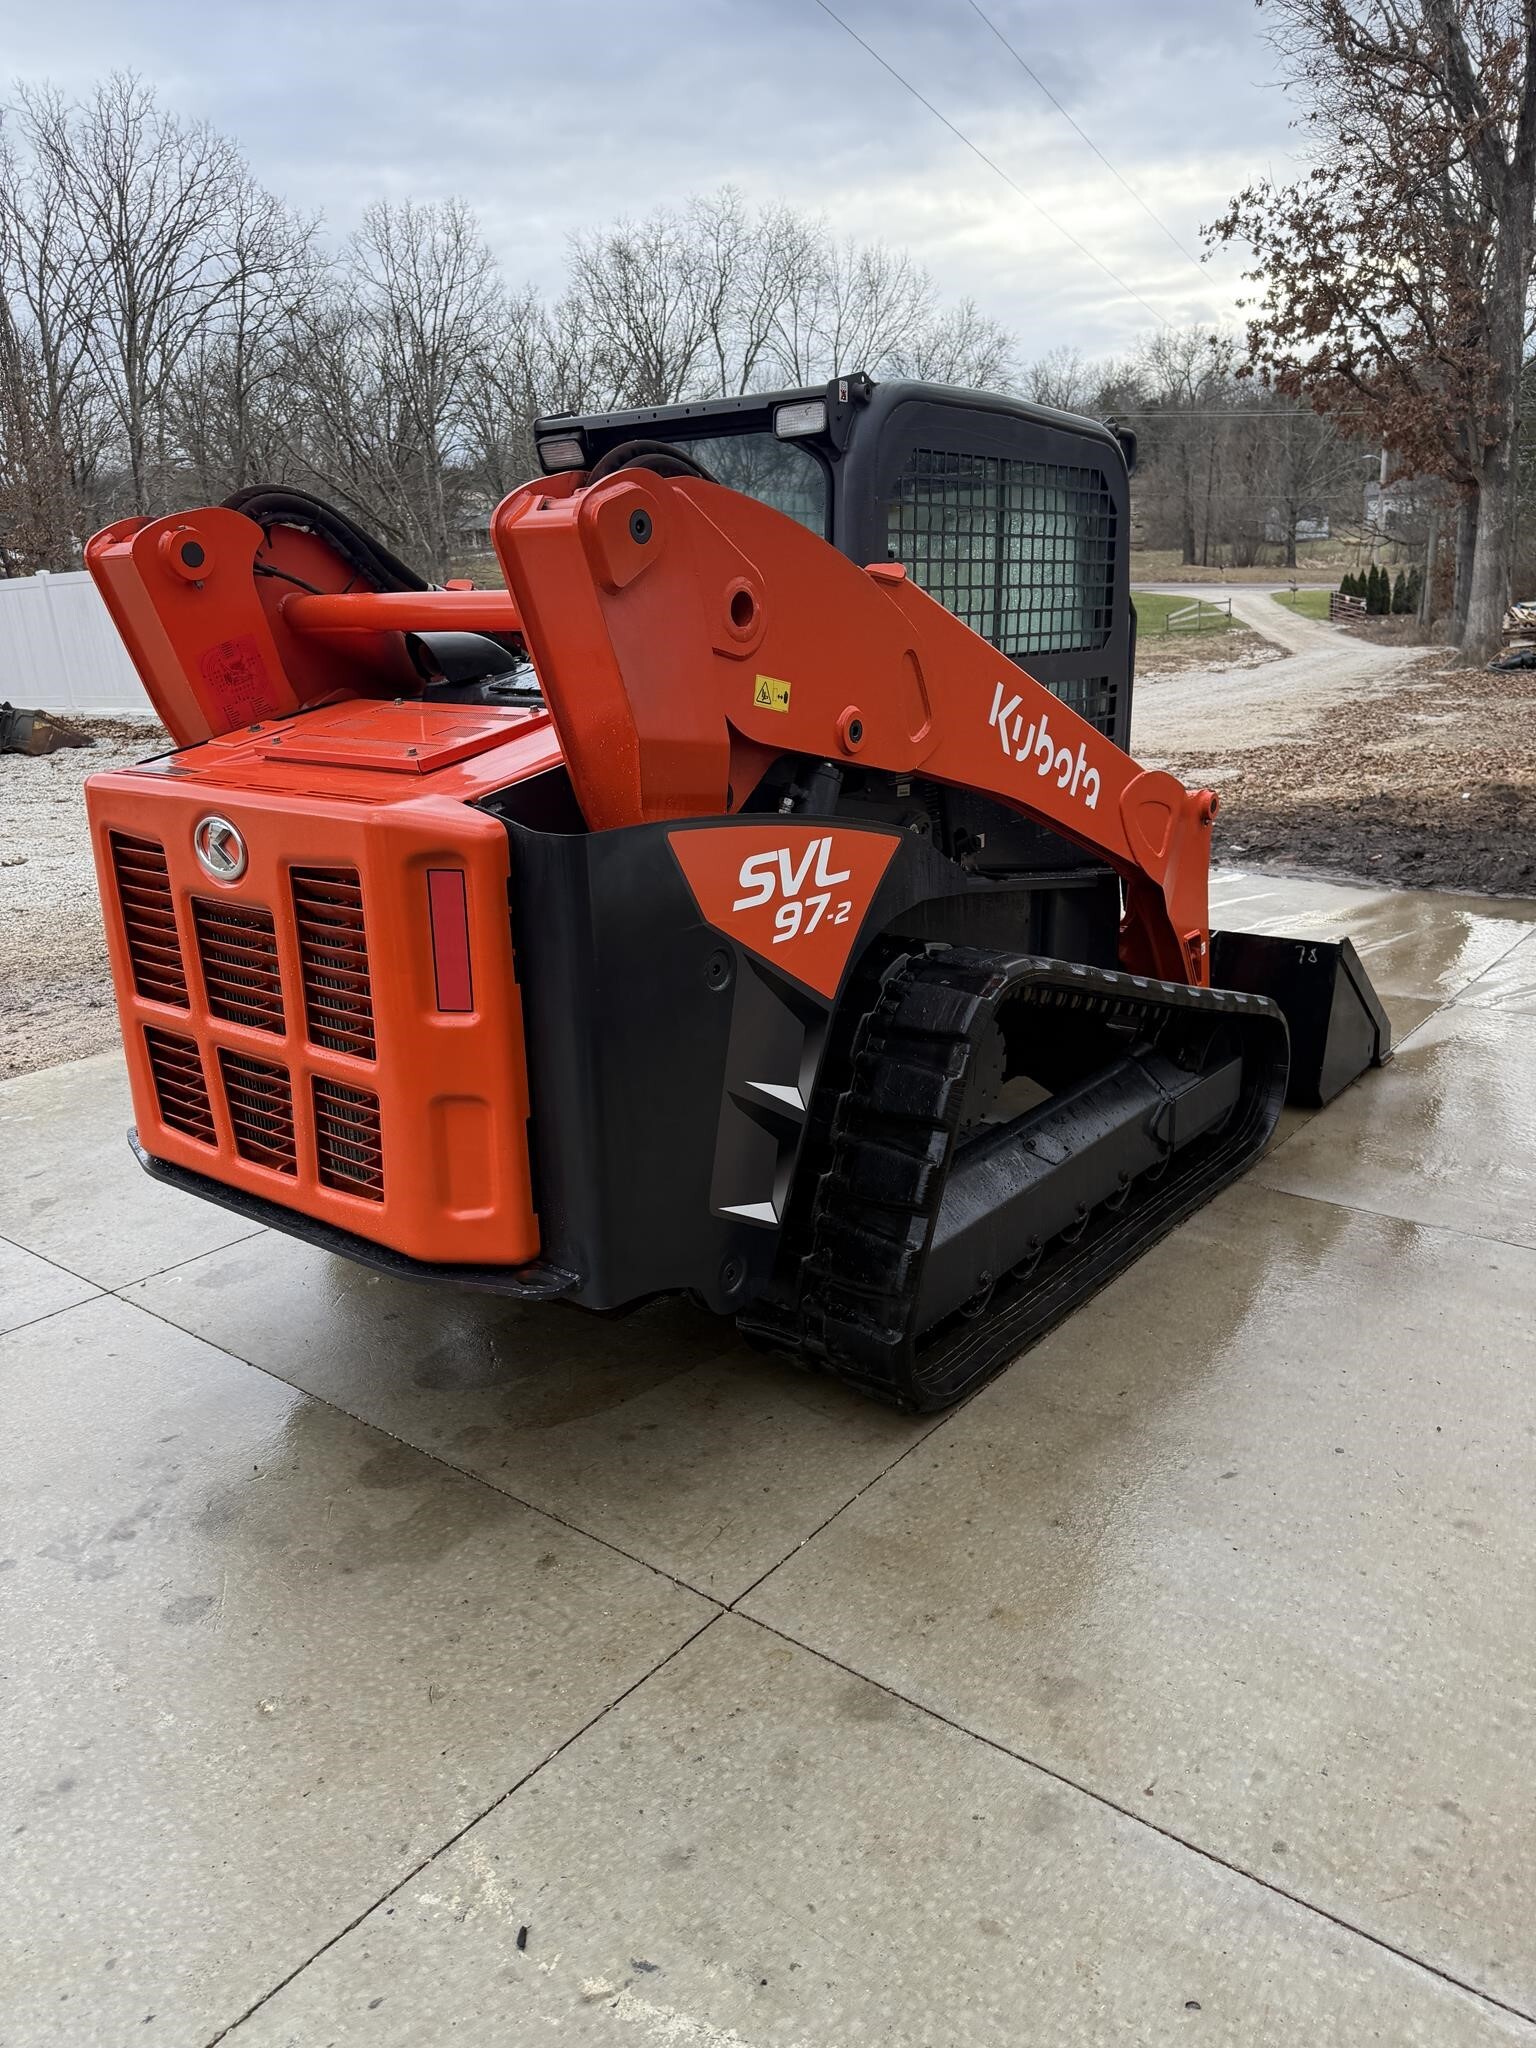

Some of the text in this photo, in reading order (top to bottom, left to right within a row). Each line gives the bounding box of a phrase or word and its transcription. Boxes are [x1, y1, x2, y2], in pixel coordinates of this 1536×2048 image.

[988, 681, 1101, 810] Kubota
[732, 836, 850, 912] SVL
[772, 892, 852, 944] 97-2
